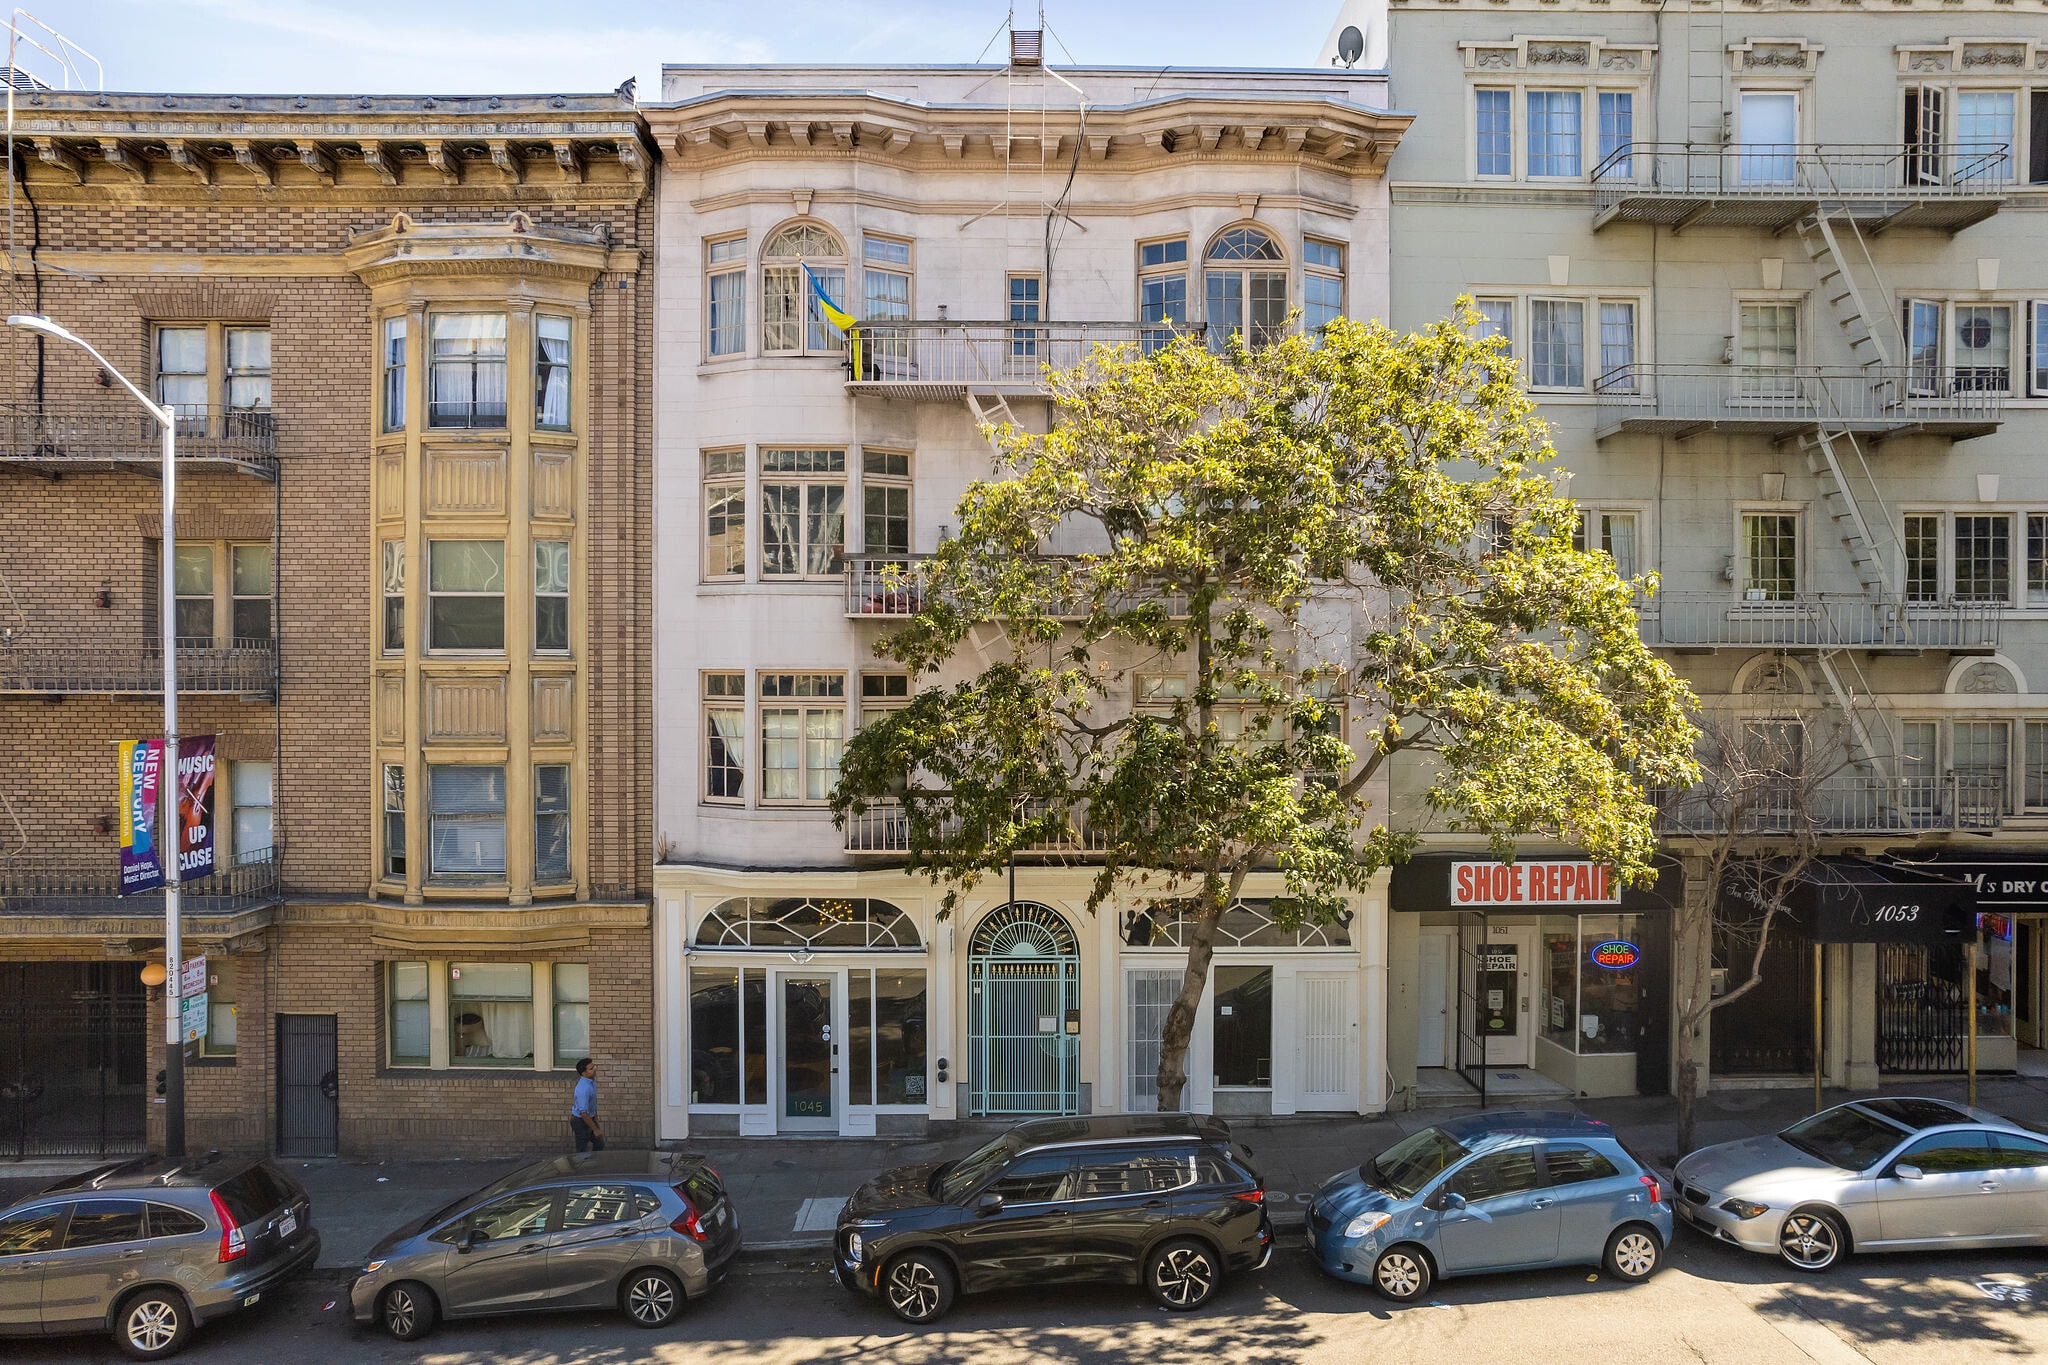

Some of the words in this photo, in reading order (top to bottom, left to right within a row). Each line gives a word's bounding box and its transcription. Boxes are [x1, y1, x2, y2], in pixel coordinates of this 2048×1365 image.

[143, 748, 160, 790] NEW
[178, 754, 214, 776] MUSIC
[131, 749, 147, 833] CENTURY
[189, 825, 207, 845] UP
[179, 847, 213, 871] CLOSE
[123, 862, 140, 874] Daniel
[123, 873, 140, 885] Music
[1457, 865, 1523, 902] SHOE
[2002, 880, 2037, 893] DRY
[1874, 904, 1920, 923] 1053
[1492, 926, 1508, 935] 1051
[1602, 944, 1630, 954] SHOE
[1598, 954, 1634, 964] REPAIR
[794, 1101, 823, 1112] 1045
